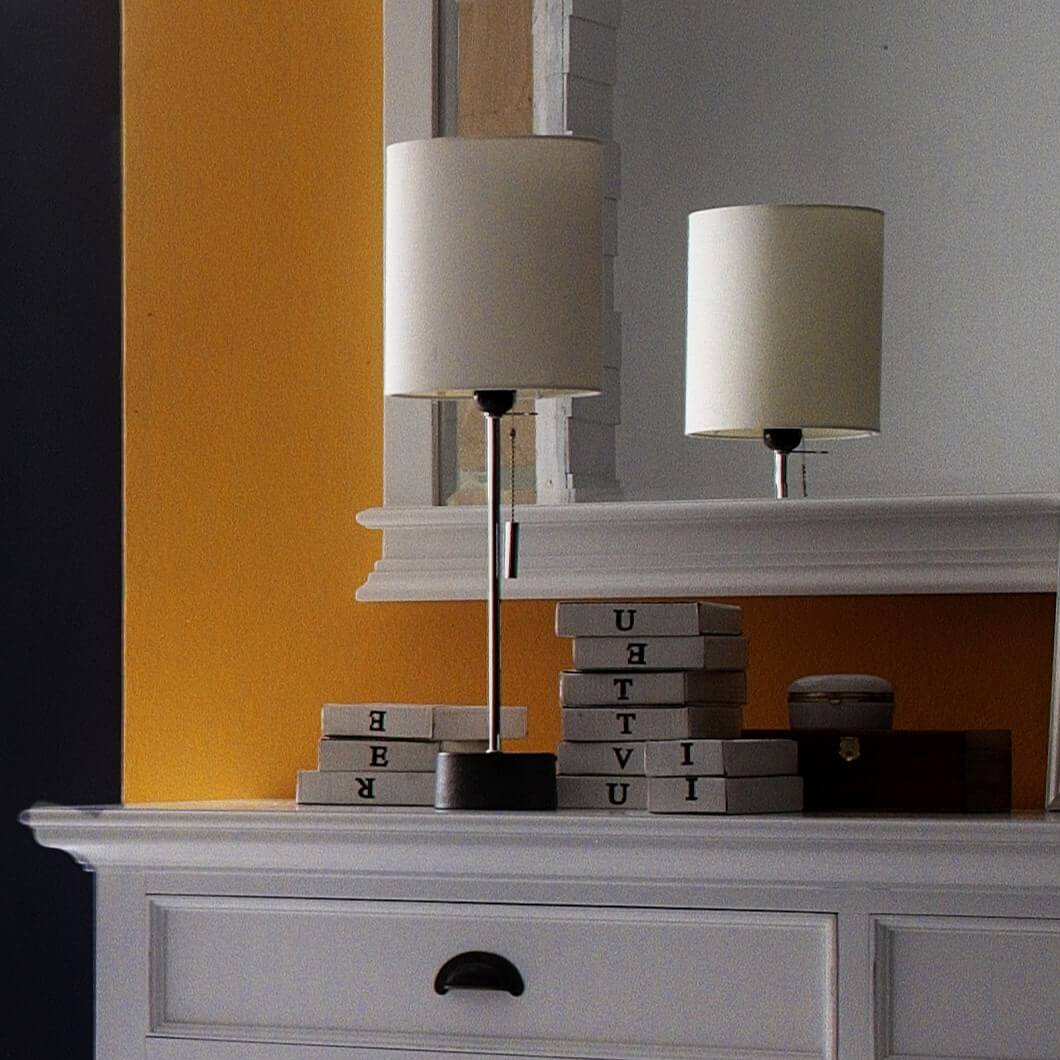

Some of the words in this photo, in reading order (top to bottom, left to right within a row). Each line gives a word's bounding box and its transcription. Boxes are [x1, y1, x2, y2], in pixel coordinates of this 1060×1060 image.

[613, 609, 637, 632] U
[626, 642, 648, 665] E
[613, 678, 634, 701] T
[368, 709, 388, 733] E
[615, 712, 637, 735] T
[368, 745, 389, 768] E
[612, 747, 635, 770] V
[680, 742, 695, 766] I
[354, 777, 377, 800] R
[605, 782, 630, 806] U
[684, 776, 699, 802] I
